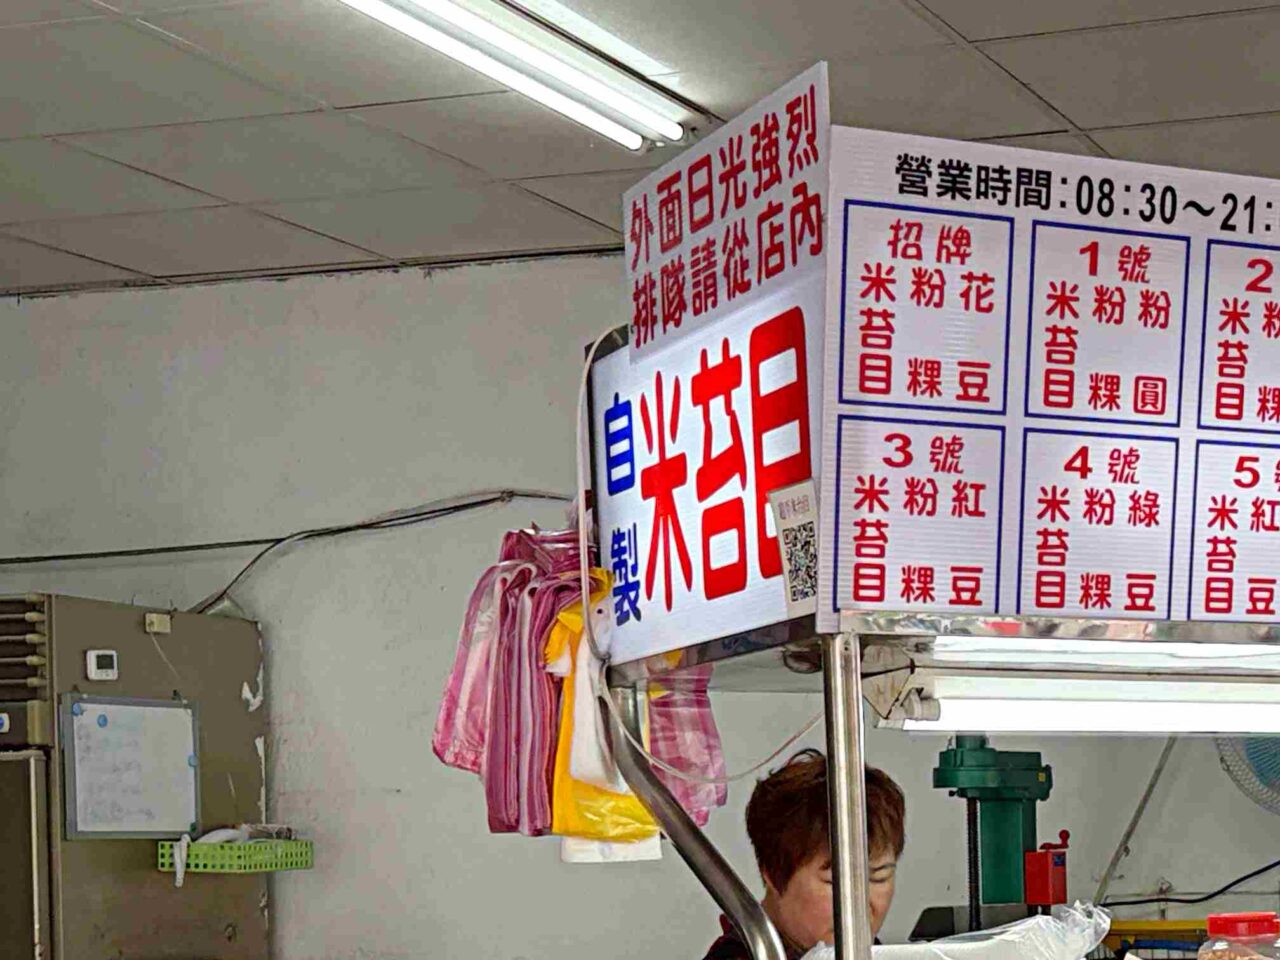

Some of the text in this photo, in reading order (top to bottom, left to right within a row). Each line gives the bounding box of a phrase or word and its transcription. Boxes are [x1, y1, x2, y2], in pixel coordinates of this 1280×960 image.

[631, 84, 819, 271] 外面日光強烈
[632, 182, 823, 342] 排隊請從店內
[888, 218, 972, 266] 招牌
[1078, 241, 1153, 285] 1號
[640, 306, 812, 612] 米苔目
[882, 433, 965, 475] 3號
[1064, 446, 1142, 485] 4號
[604, 392, 641, 626] 自製
